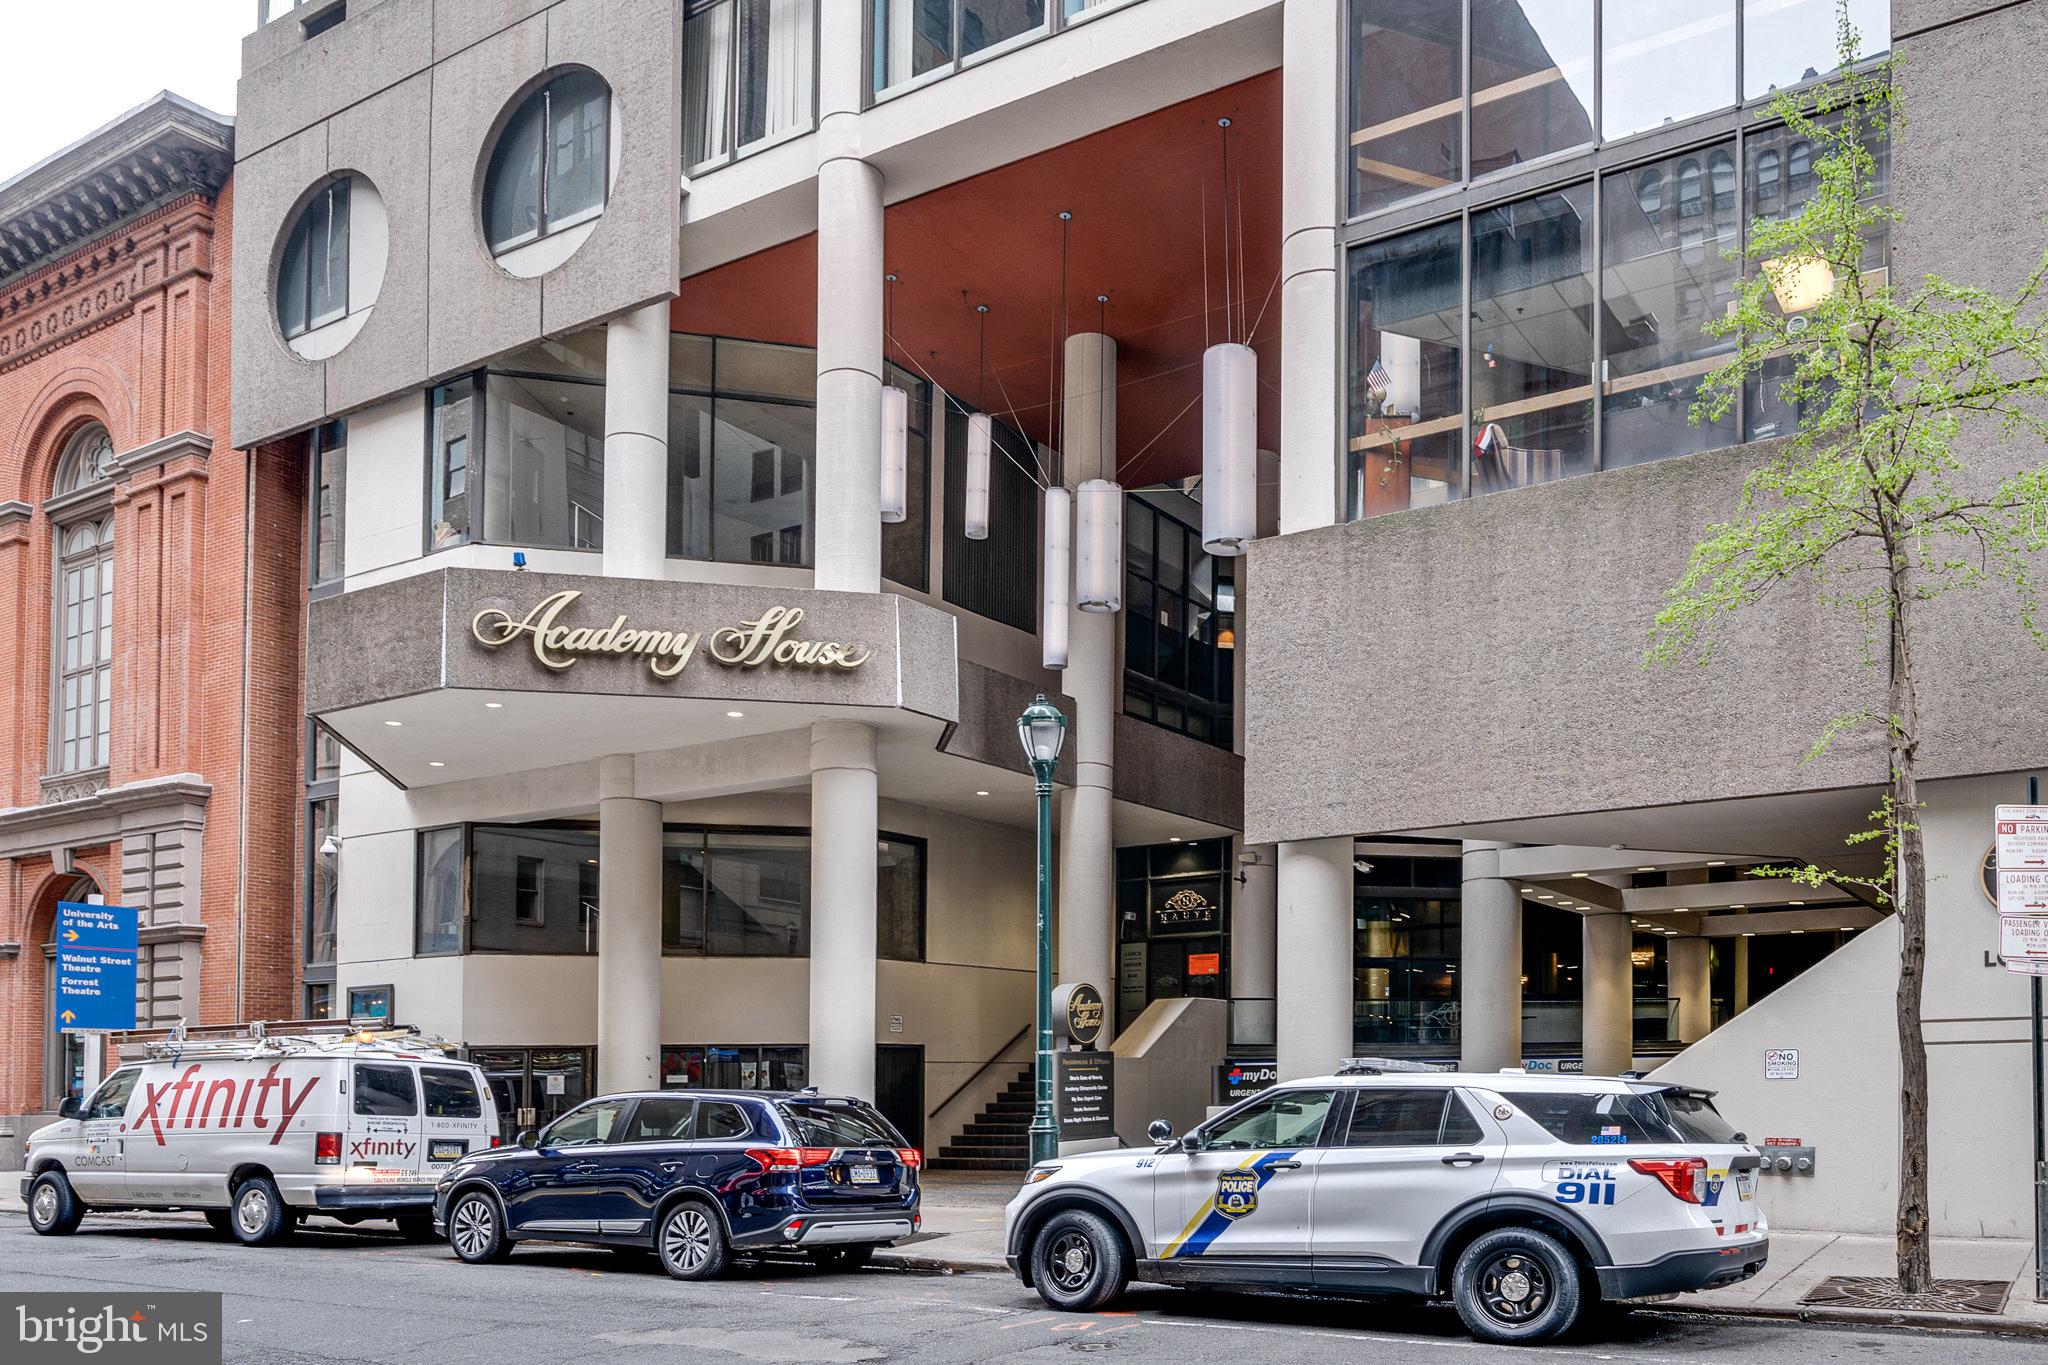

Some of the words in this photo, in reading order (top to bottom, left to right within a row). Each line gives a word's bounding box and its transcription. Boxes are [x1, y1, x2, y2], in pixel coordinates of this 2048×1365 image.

[472, 590, 701, 677] Academy
[709, 605, 870, 668] House
[2001, 824, 2014, 833] NO
[2006, 875, 2040, 884] LOADING
[63, 908, 114, 922] University
[62, 918, 73, 928] of
[77, 919, 94, 928] the
[96, 920, 120, 930] Arts
[2012, 928, 2040, 936] LOADING
[62, 954, 96, 964] Walnut
[100, 956, 132, 965] Street
[62, 964, 101, 973] Theatre
[62, 977, 98, 986] Forrest
[61, 986, 101, 996] Theatre
[1242, 1068, 1276, 1082] myDo
[132, 1062, 321, 1146] xfinity
[350, 1138, 416, 1159] xfinity
[75, 1156, 115, 1166] COMCAST
[1136, 1158, 1155, 1168] 912
[1558, 1168, 1616, 1180] DIAL
[1221, 1181, 1254, 1193] POLICE
[1555, 1182, 1615, 1205] 911
